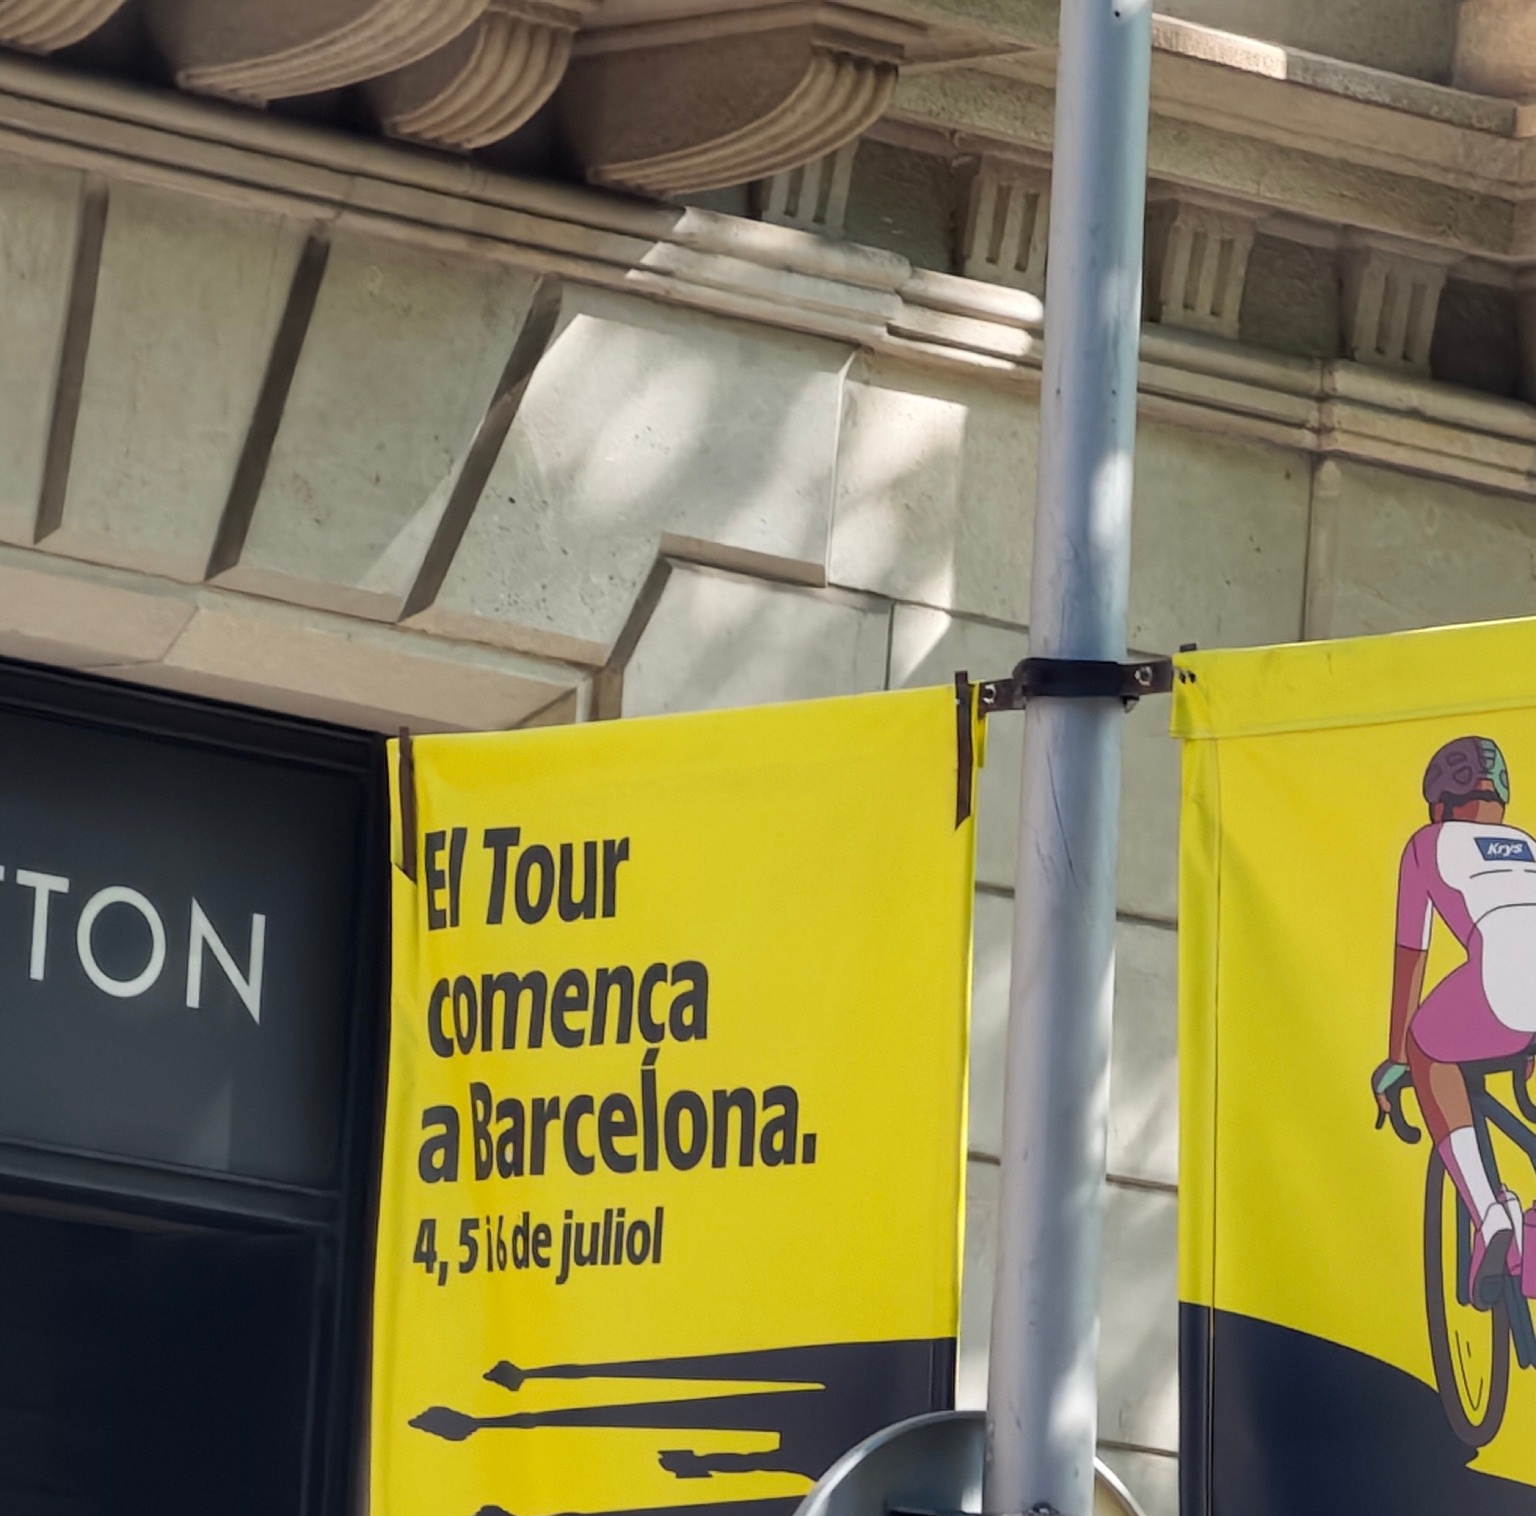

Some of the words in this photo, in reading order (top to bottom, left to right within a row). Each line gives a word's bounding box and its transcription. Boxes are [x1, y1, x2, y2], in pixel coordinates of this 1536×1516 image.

[425, 827, 467, 931] El
[483, 826, 629, 925] Tour
[1487, 842, 1523, 857] Krys
[0, 865, 266, 1025] TON
[428, 960, 708, 1065] comença
[418, 1104, 460, 1183] a
[469, 1068, 817, 1181] Barcelona.
[413, 1218, 448, 1286] 4,
[458, 1218, 480, 1273] 5
[512, 1212, 551, 1269] de
[555, 1207, 664, 1284] juliol
